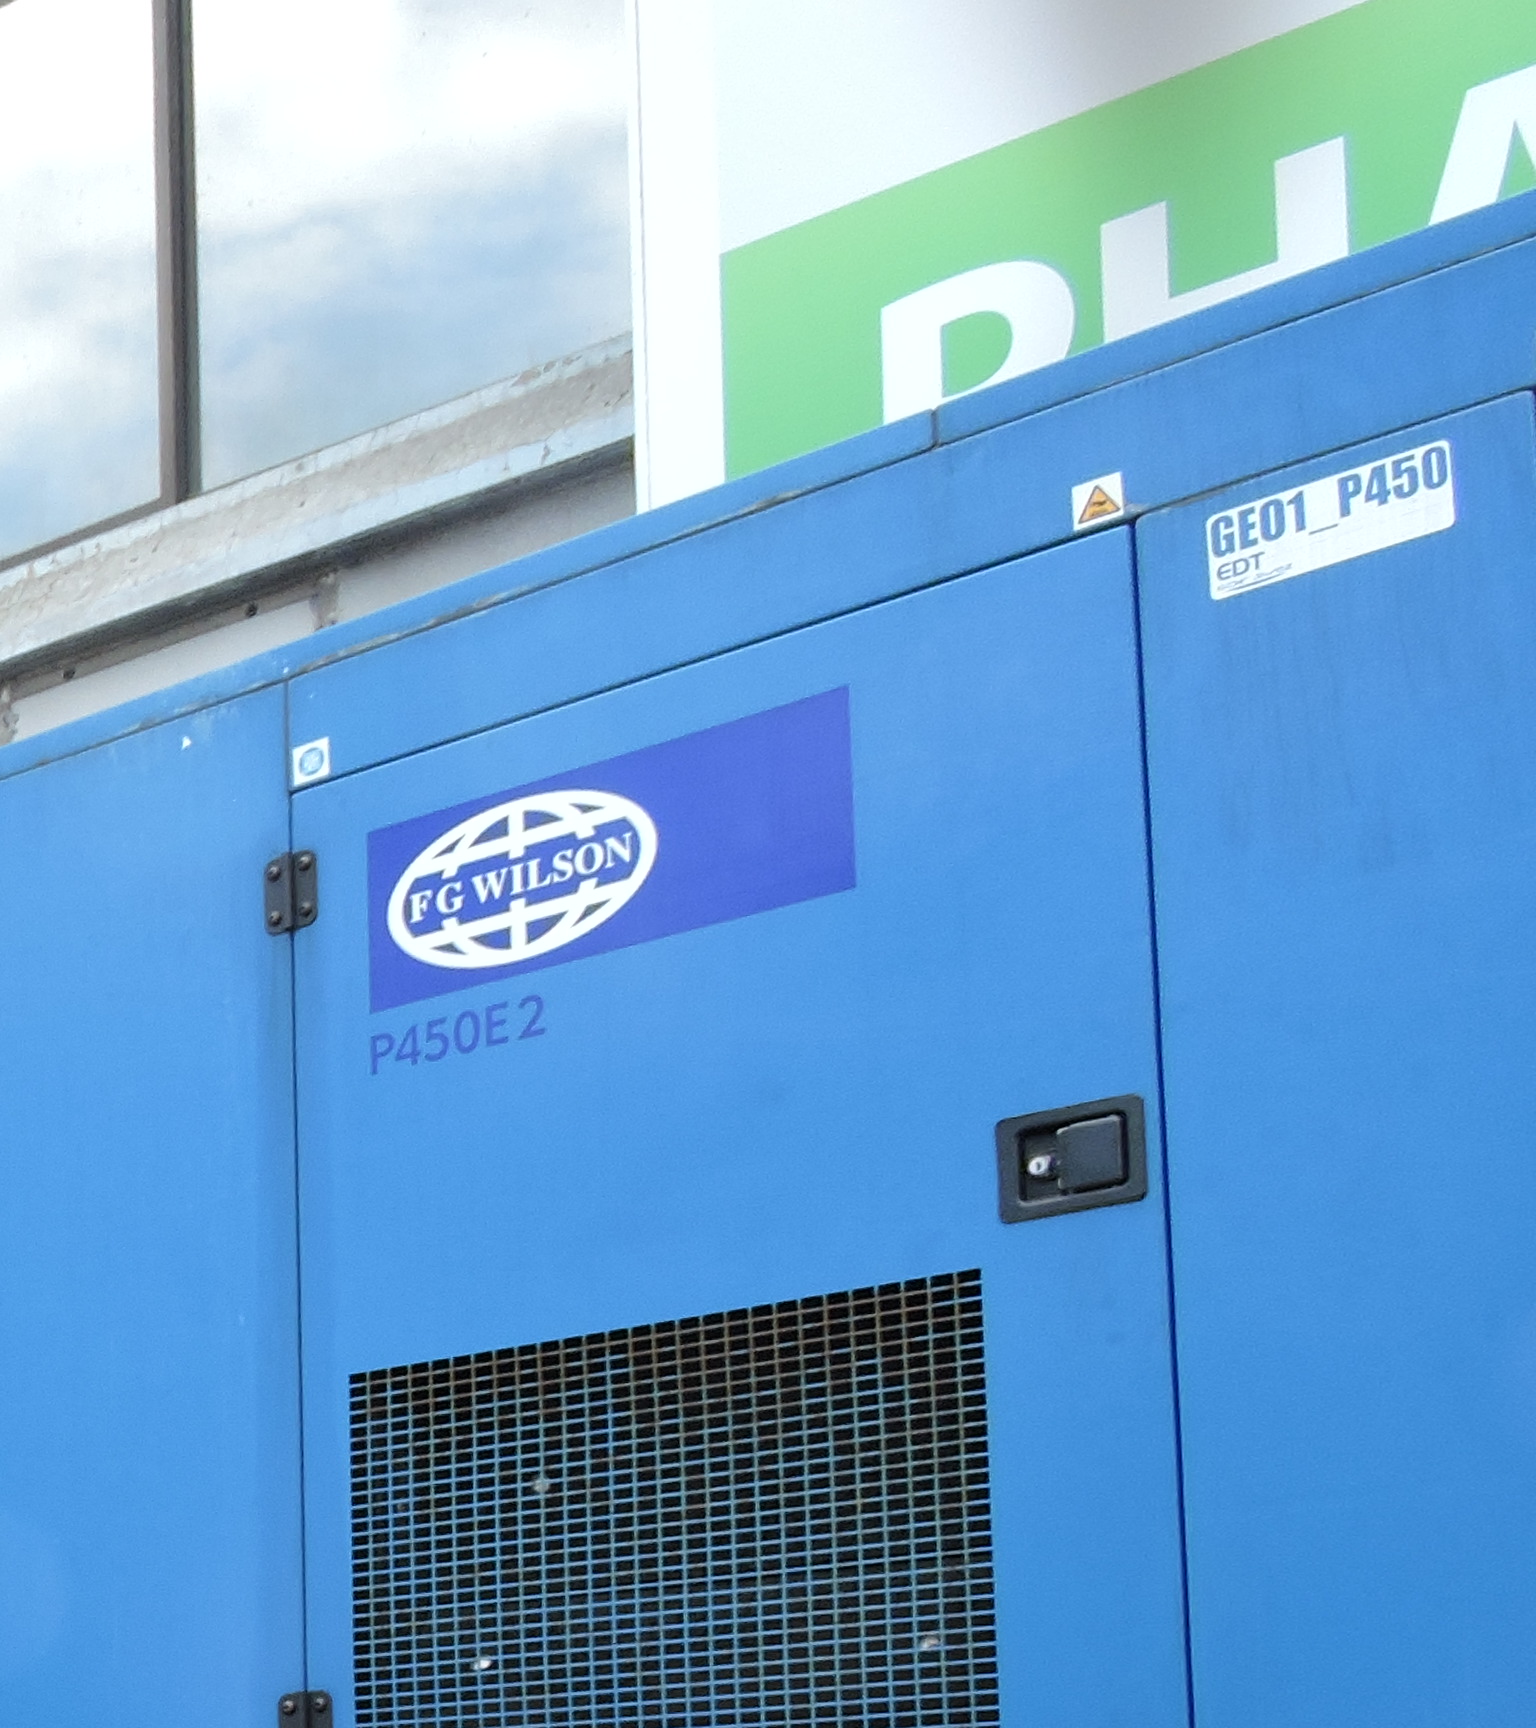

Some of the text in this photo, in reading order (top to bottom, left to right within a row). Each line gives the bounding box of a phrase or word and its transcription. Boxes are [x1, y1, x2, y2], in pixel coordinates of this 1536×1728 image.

[1216, 551, 1266, 581] EDT
[409, 832, 633, 923] FG WILSON
[370, 994, 546, 1076] P450E2
